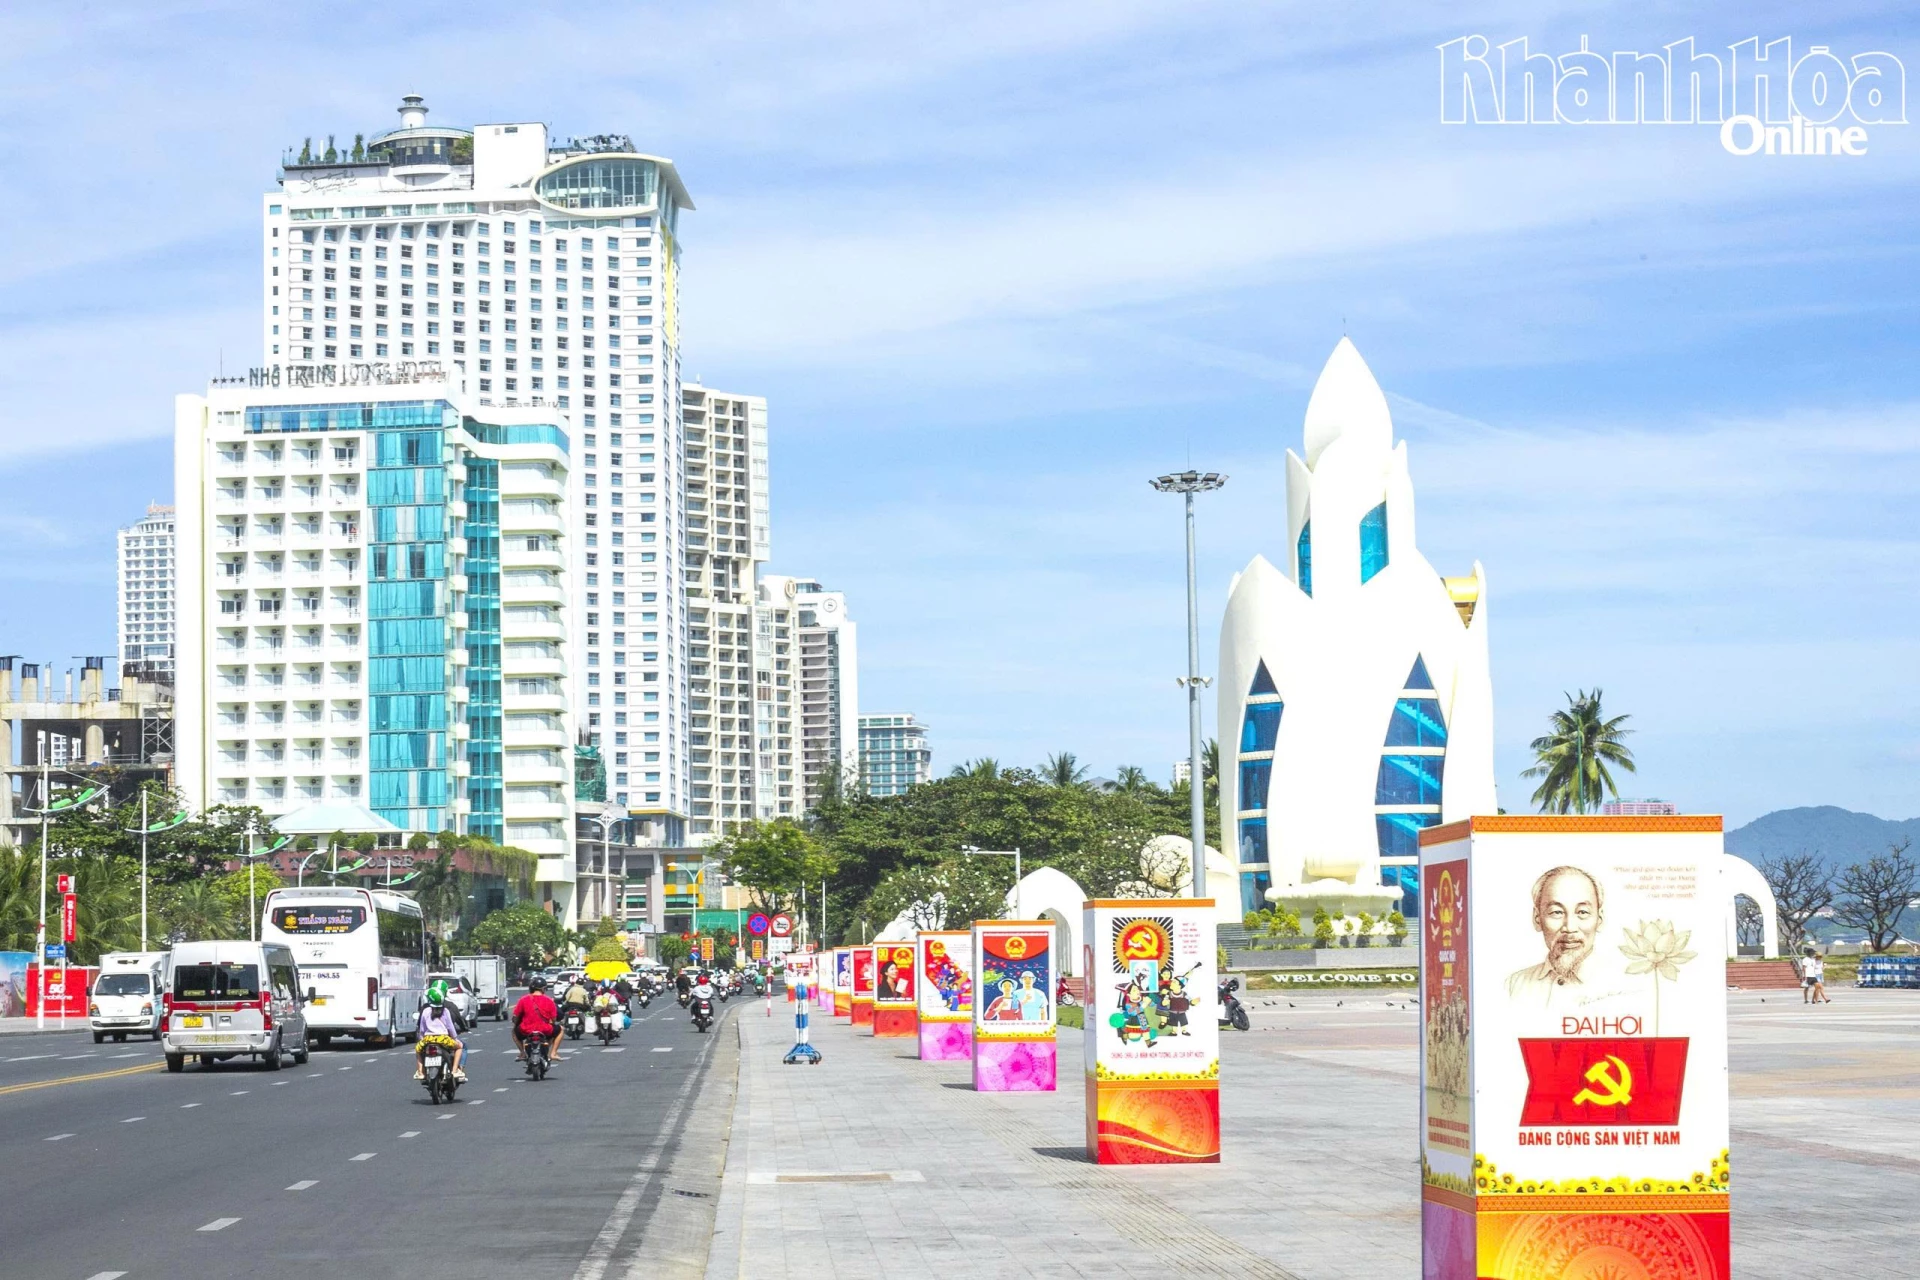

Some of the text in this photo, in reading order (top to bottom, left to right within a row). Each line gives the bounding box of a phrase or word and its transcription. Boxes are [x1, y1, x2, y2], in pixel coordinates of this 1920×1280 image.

[1271, 973, 1415, 983] WELCOME TO
[1602, 1014, 1642, 1036] HỘI
[1518, 1127, 1680, 1148] ĐẢNG CỘNG SẢN VIỆT NAM
